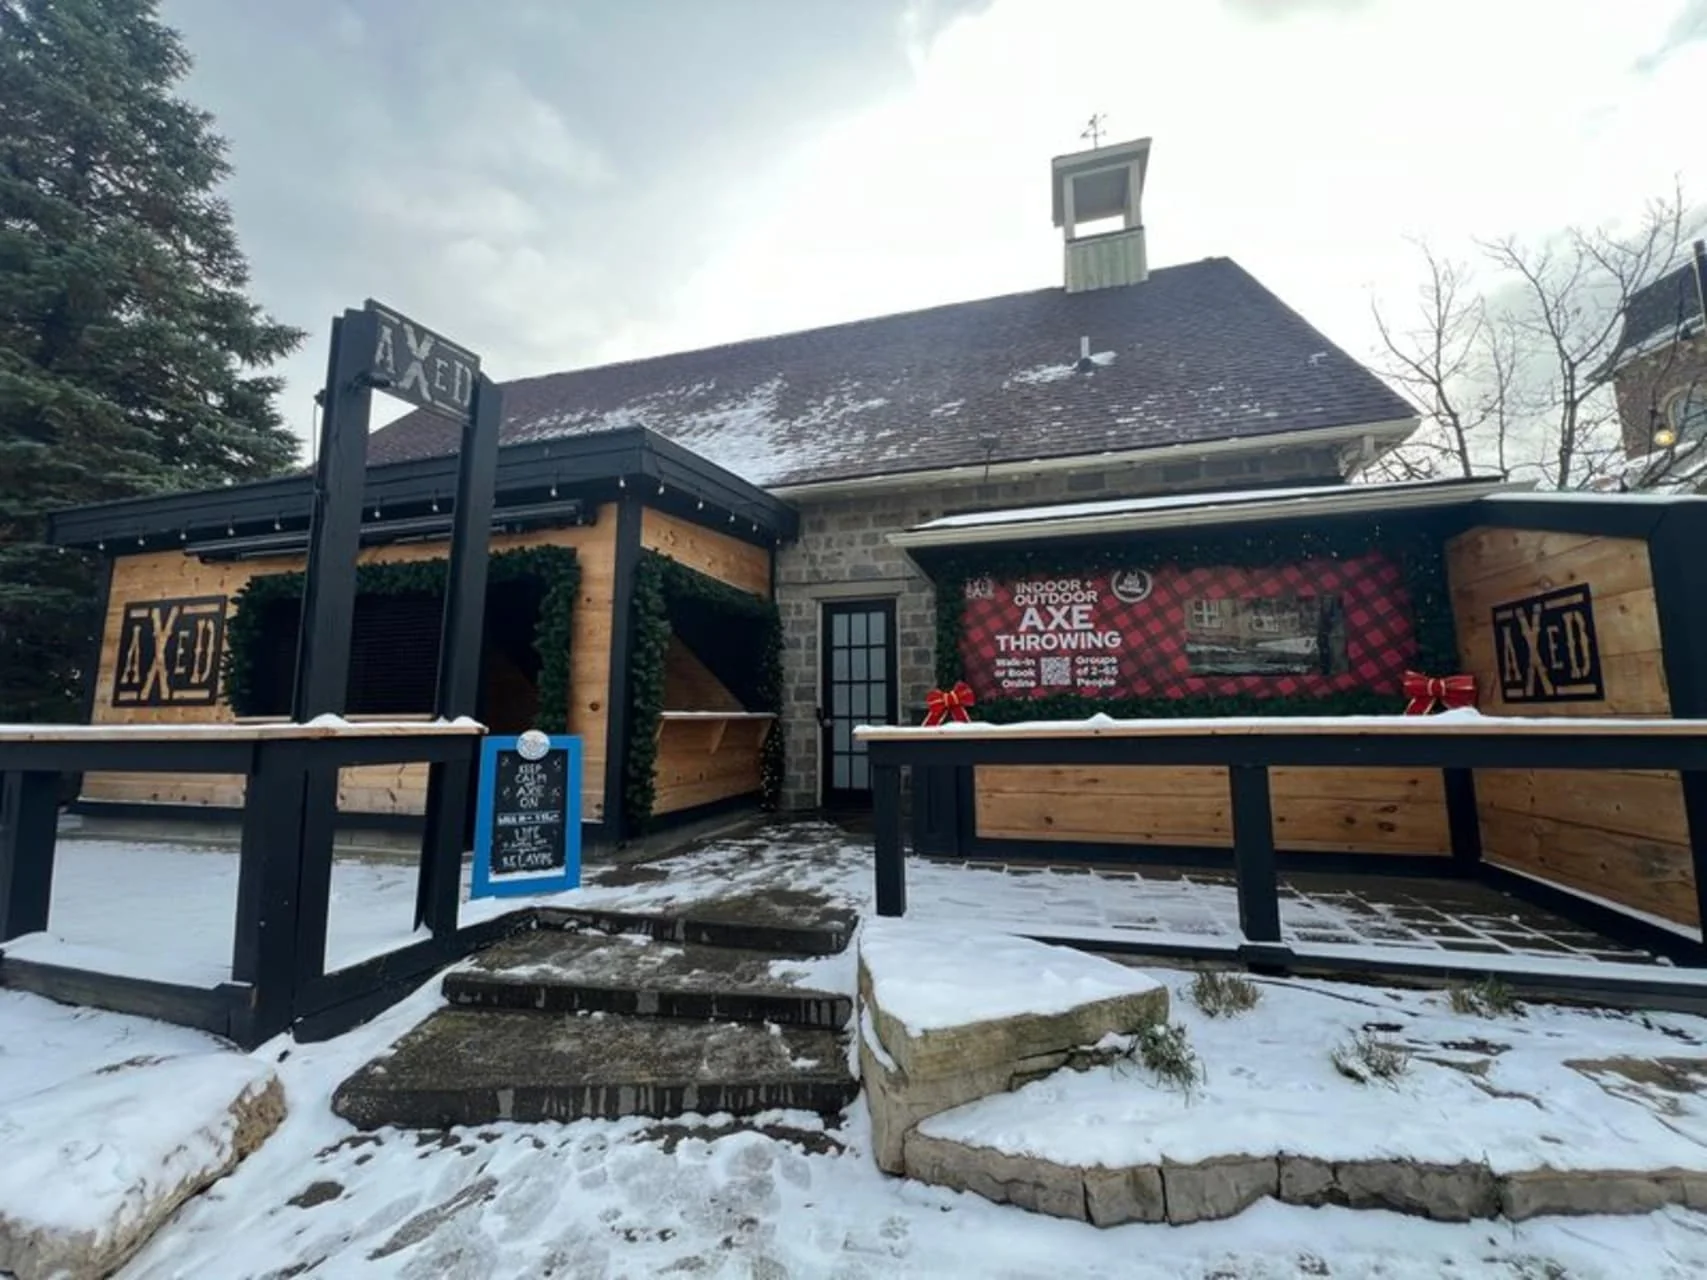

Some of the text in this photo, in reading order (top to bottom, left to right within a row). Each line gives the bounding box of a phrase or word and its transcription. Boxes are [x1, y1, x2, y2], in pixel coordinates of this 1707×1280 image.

[1015, 580, 1081, 595] INDOOR
[1013, 590, 1098, 607] OUTDOOR
[1018, 604, 1095, 632] AXE
[995, 631, 1122, 652] THROWING
[1075, 656, 1118, 667] Groups
[1008, 667, 1036, 678] Book
[1001, 678, 1037, 689] Online
[1076, 676, 1117, 689] People
[515, 773, 547, 785] CALM
[519, 798, 539, 809] ON
